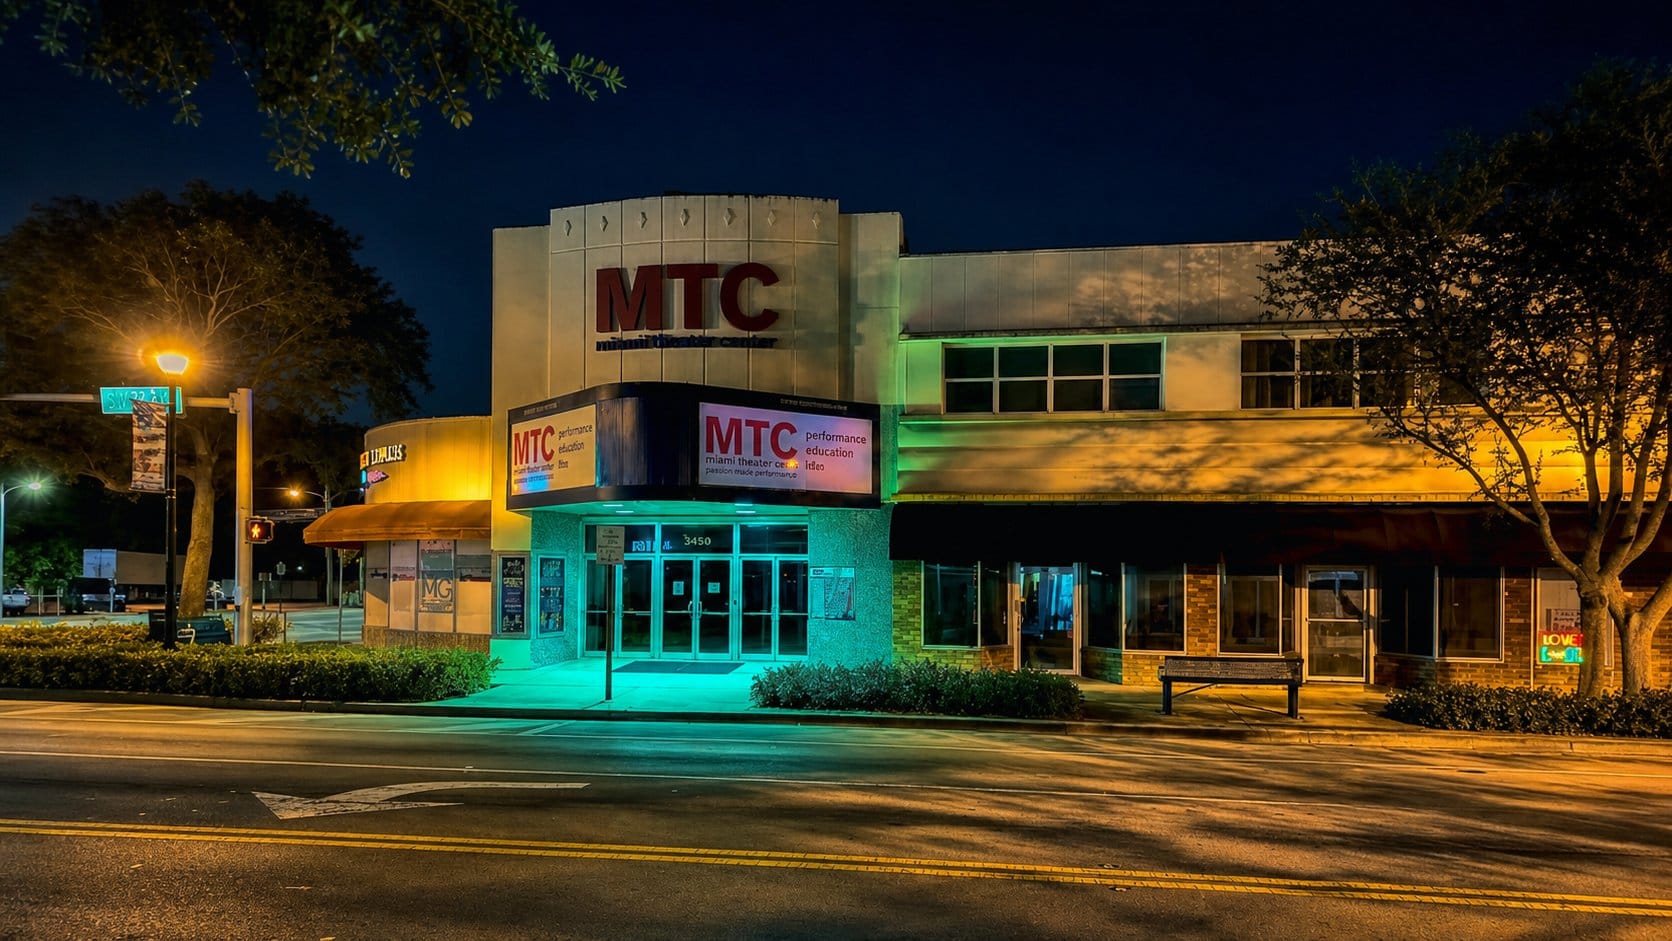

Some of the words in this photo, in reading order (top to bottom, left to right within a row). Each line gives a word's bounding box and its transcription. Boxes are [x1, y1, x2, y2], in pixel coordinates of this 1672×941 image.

[596, 262, 780, 333] MTC
[558, 424, 593, 440] performance
[705, 416, 798, 460] MTC
[805, 430, 867, 445] performance
[514, 425, 555, 465] MTC
[558, 440, 585, 454] education
[805, 446, 854, 459] education
[705, 455, 736, 466] miami
[738, 457, 772, 468] theater
[684, 536, 712, 546] 3450
[421, 577, 453, 600] MG
[1543, 634, 1581, 646] LOVE
